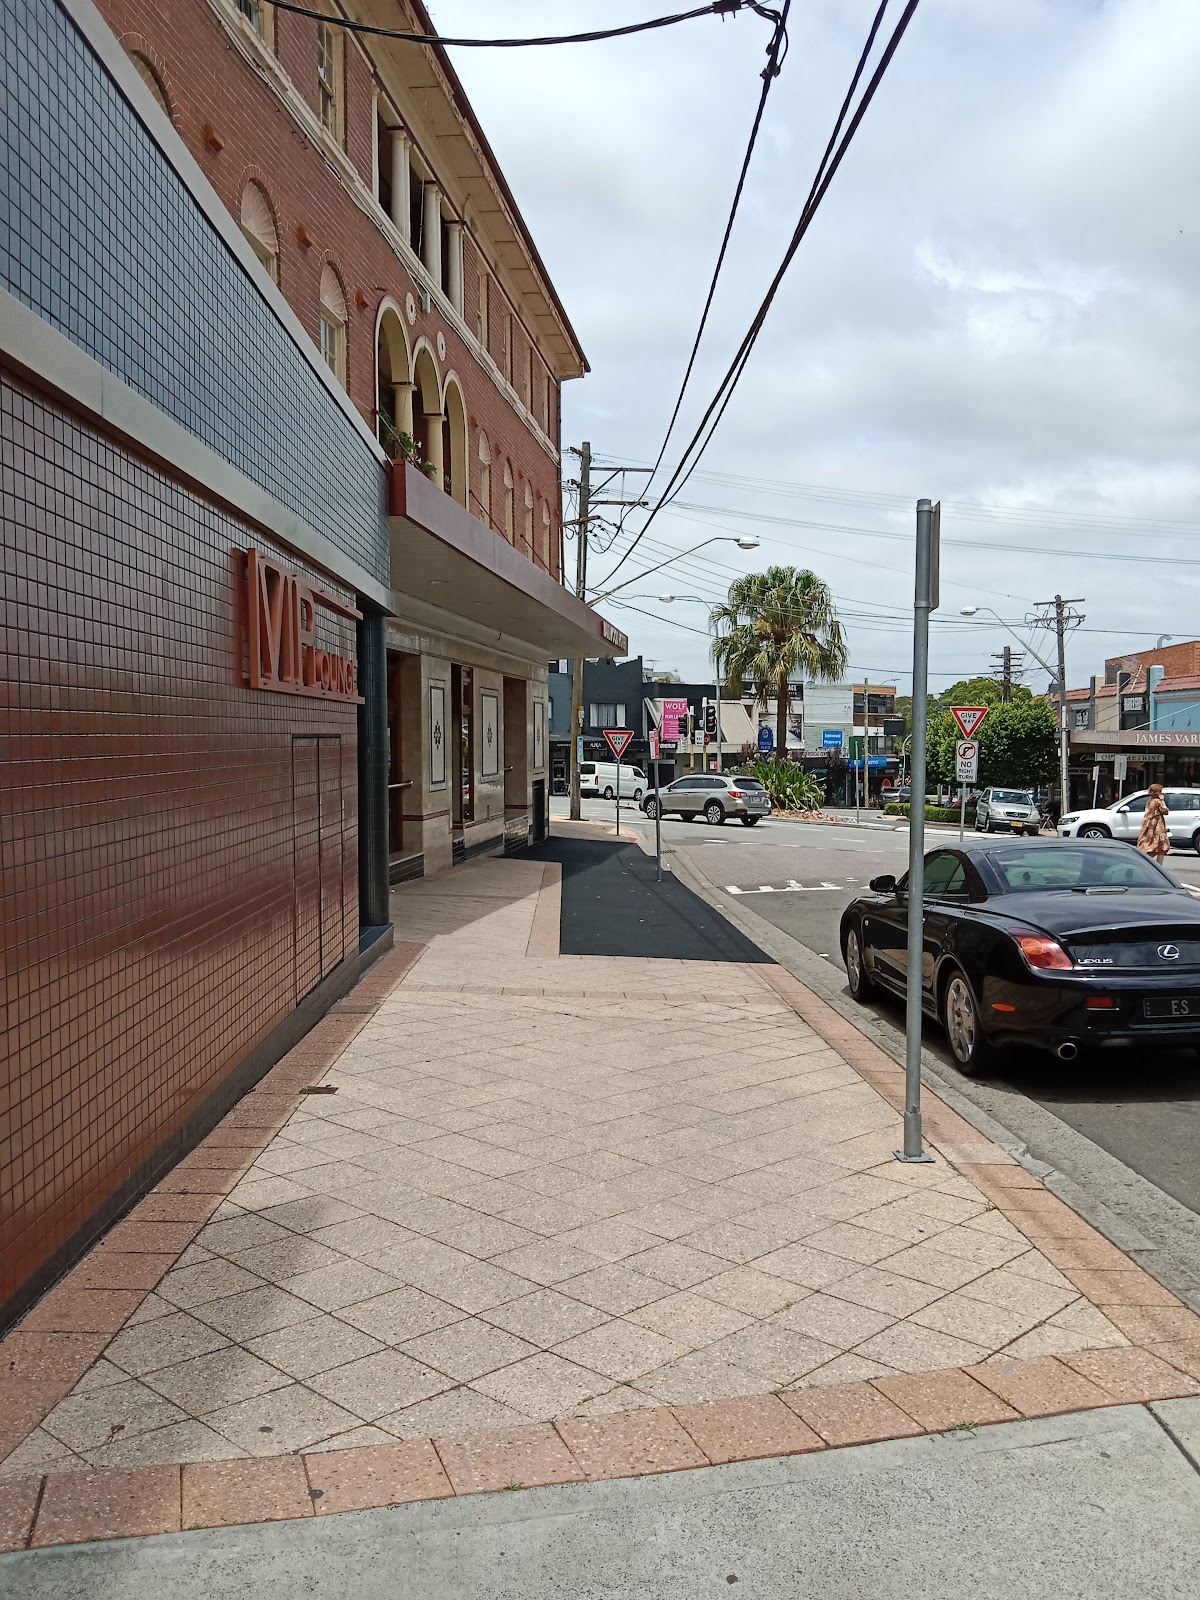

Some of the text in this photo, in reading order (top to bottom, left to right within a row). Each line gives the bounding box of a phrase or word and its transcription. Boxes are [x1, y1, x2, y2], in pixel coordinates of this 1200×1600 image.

[254, 556, 317, 690] VIP
[664, 702, 687, 710] WOLF
[1134, 732, 1200, 744] JAMES VAR
[1101, 753, 1161, 762] OPTMETRIST
[1077, 957, 1114, 965] LEXUS
[1171, 1000, 1189, 1015] ES
